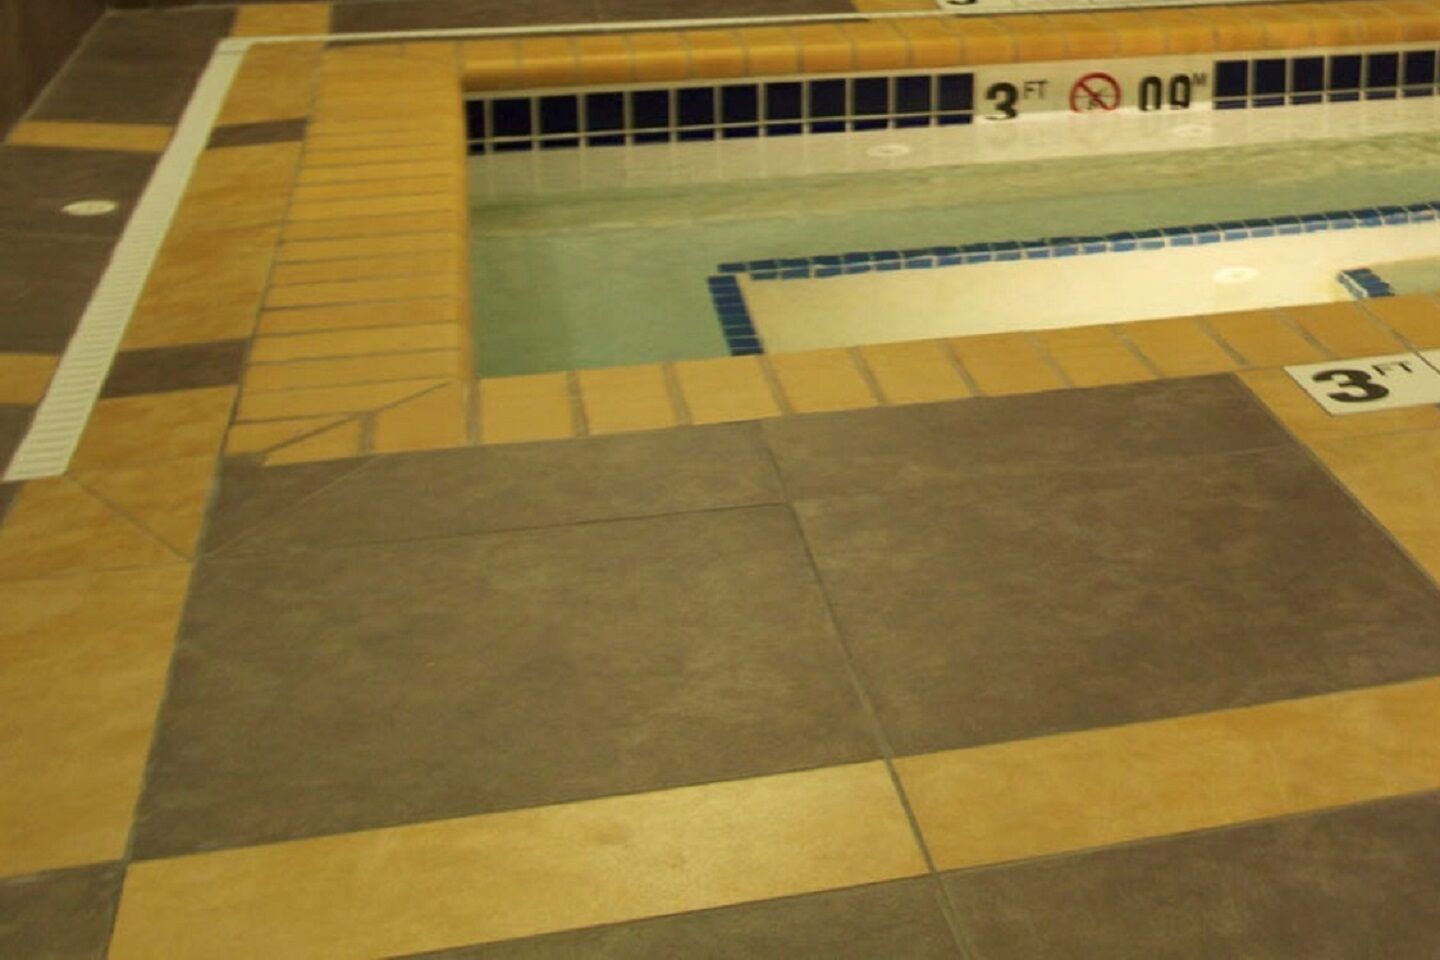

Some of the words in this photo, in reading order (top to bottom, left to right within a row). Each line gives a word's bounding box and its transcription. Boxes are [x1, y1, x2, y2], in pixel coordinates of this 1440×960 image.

[986, 82, 1018, 120] 3
[1023, 79, 1048, 99] FT
[1312, 369, 1389, 402] 3
[1371, 361, 1412, 376] FT
